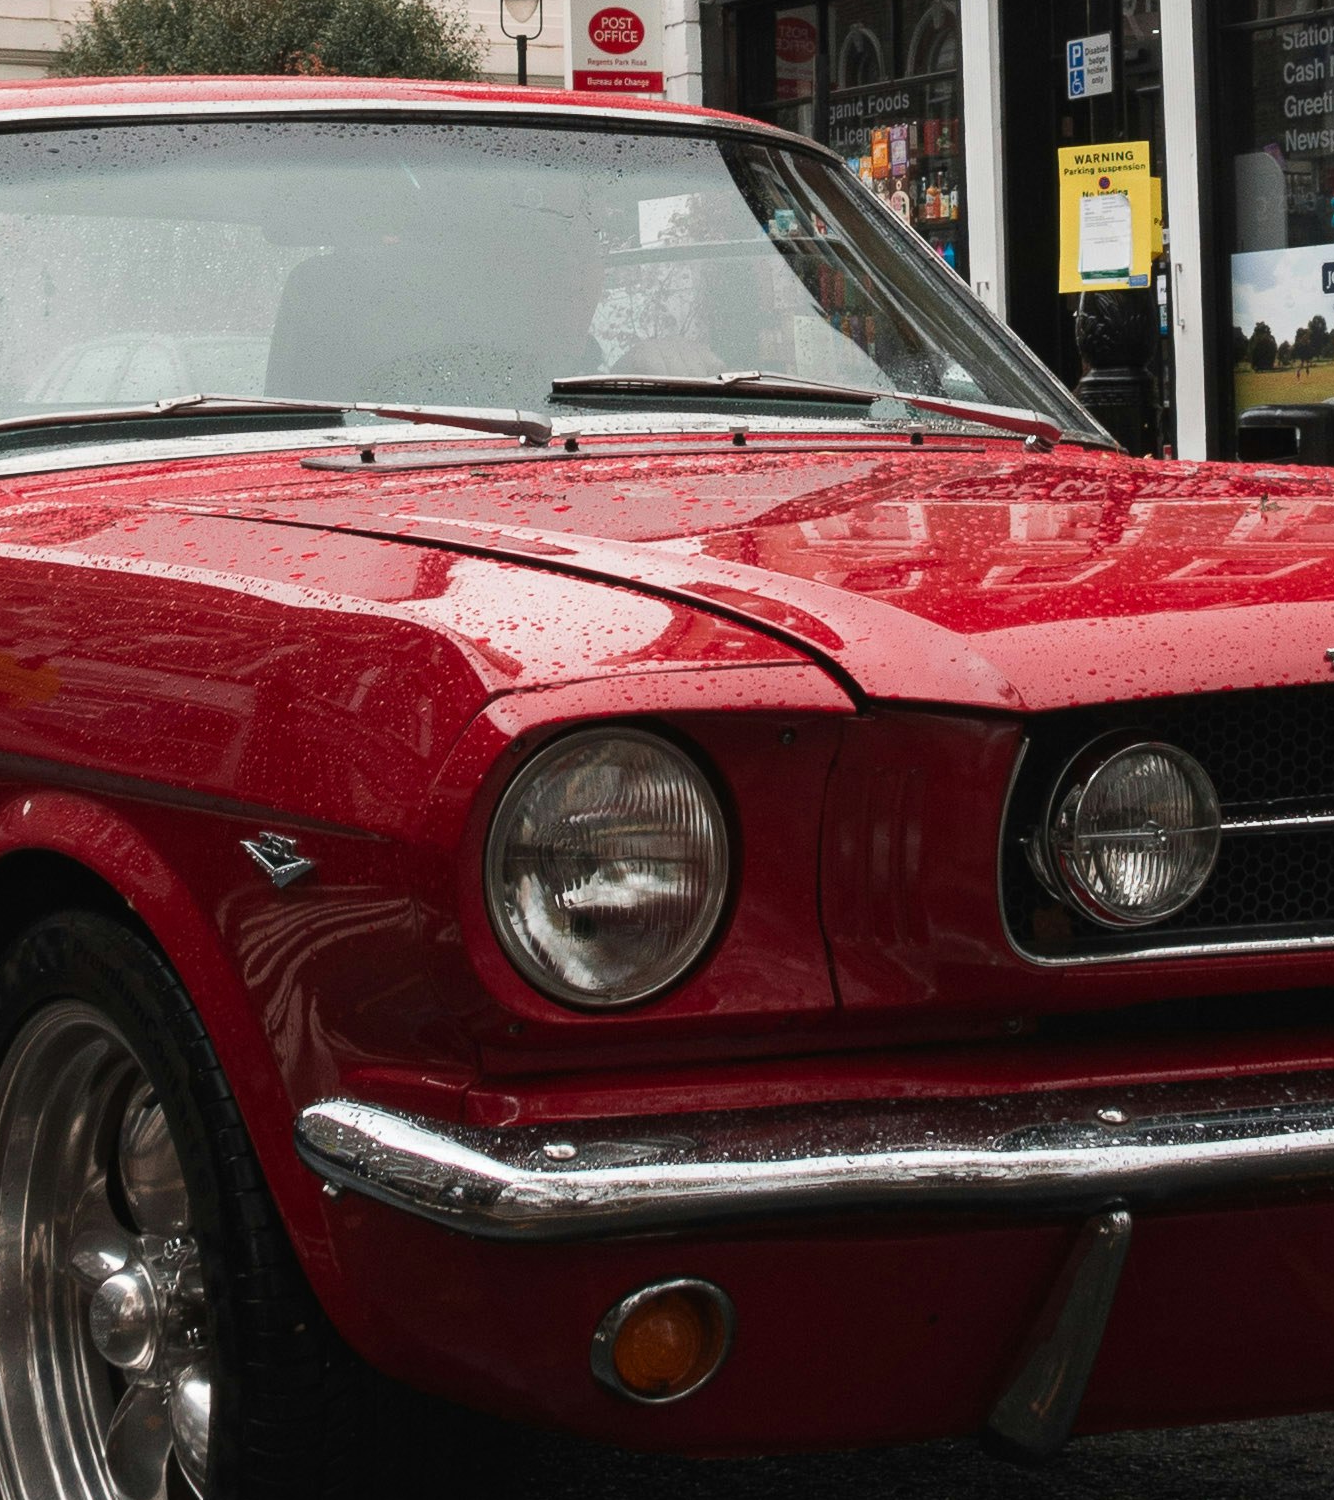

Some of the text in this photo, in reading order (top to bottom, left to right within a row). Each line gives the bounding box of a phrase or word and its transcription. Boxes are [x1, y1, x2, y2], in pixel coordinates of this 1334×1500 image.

[601, 16, 634, 30] POST
[593, 30, 639, 43] OFFICE
[1085, 44, 1109, 56] Disabled
[587, 58, 613, 66] Regents
[614, 58, 630, 66] Park
[1088, 55, 1106, 65] badge
[1087, 65, 1108, 75] holders
[1283, 58, 1325, 84] Cash
[587, 77, 650, 88] Bureau de Change
[1091, 75, 1104, 84] only
[829, 90, 910, 125] ganic Foods
[1074, 150, 1134, 165] WARNING
[1063, 162, 1146, 176] Parking suspension
